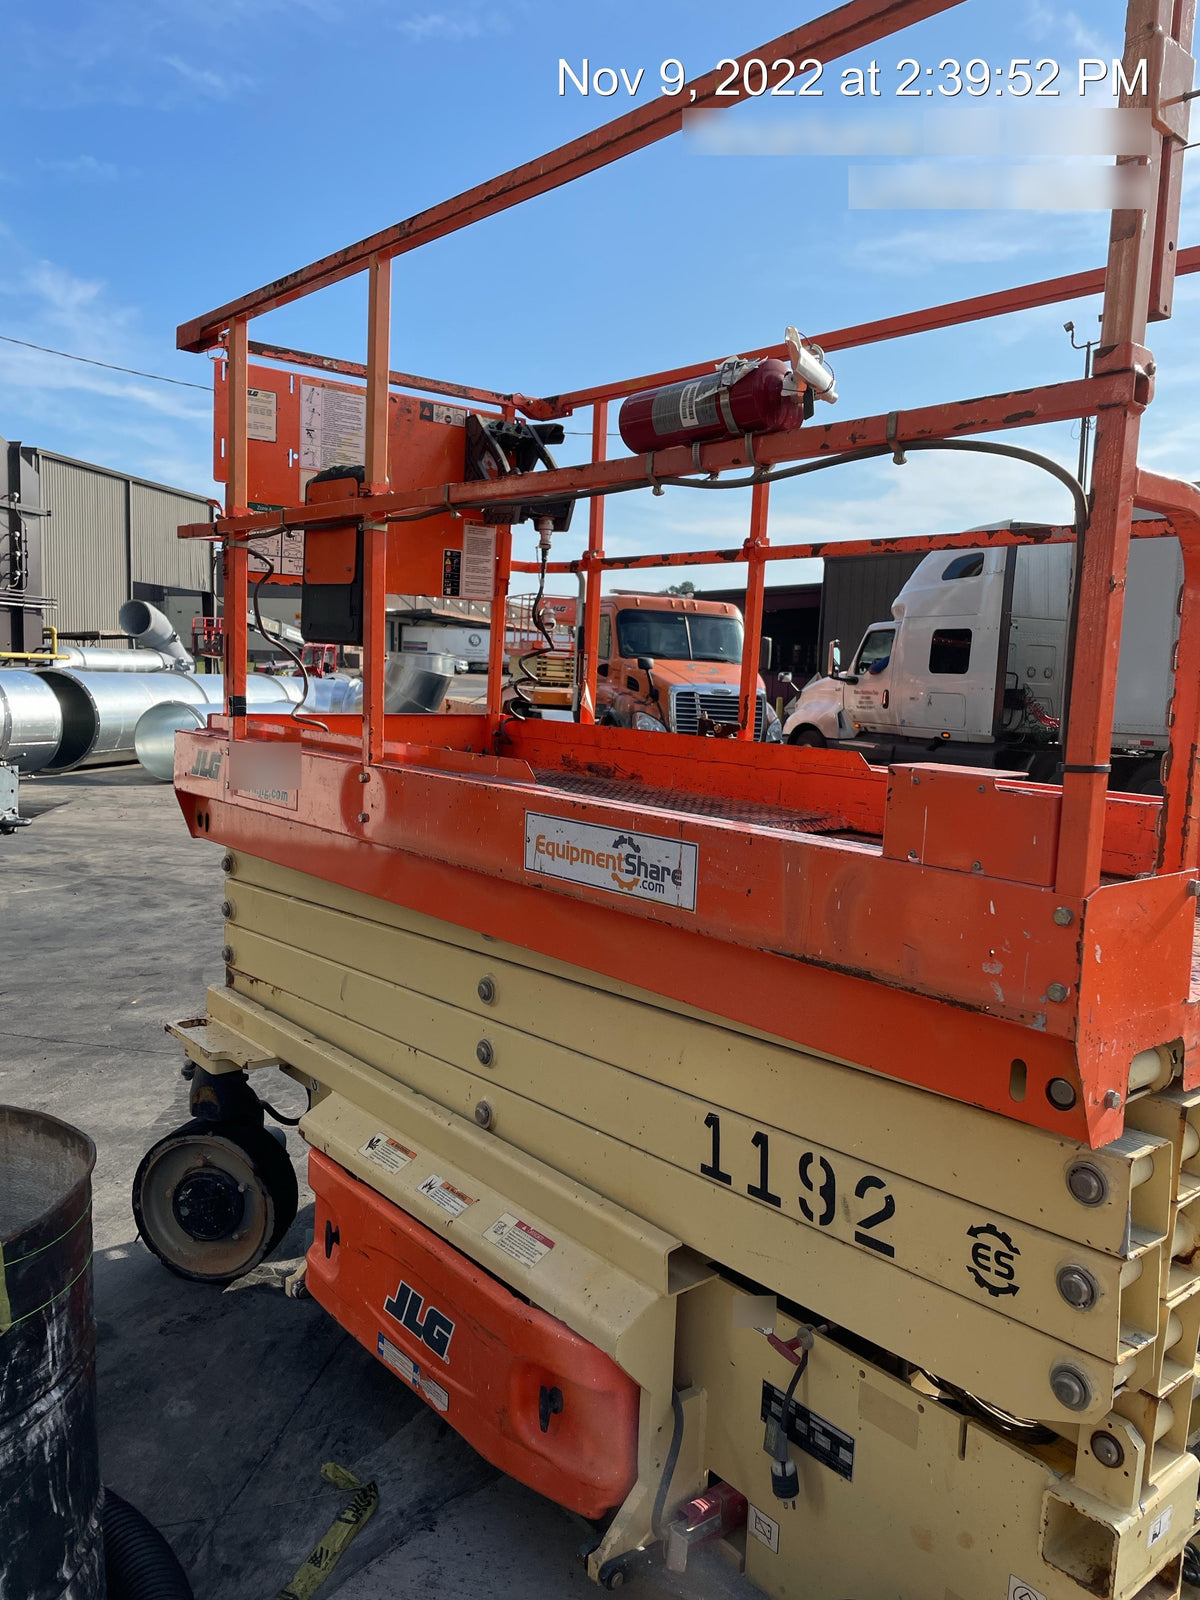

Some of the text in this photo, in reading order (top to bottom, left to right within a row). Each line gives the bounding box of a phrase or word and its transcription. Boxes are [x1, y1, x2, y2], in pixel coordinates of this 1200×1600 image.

[190, 749, 222, 780] JLG
[535, 834, 683, 886] EquipmentShare
[700, 1112, 896, 1258] 1192
[972, 1242, 1015, 1281] ES
[383, 1280, 456, 1360] JLG
